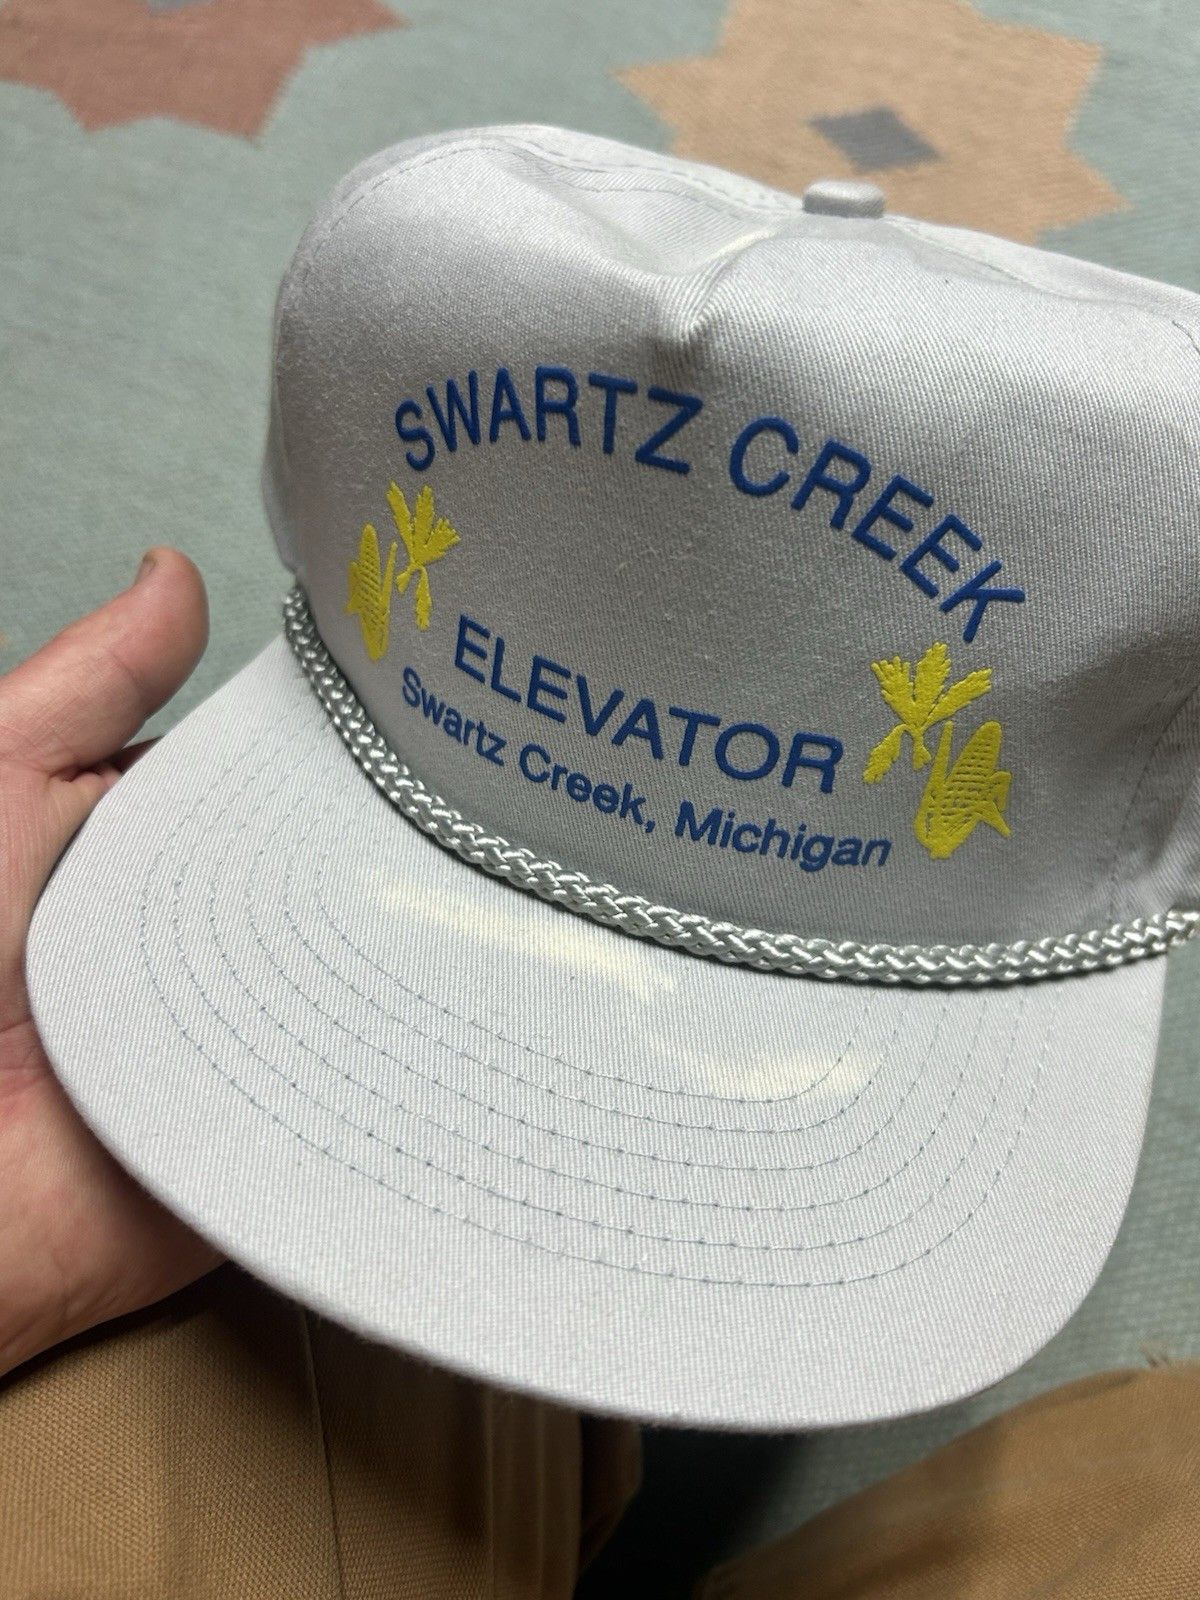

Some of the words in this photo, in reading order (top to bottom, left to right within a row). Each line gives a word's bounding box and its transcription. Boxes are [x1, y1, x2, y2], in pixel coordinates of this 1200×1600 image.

[395, 365, 704, 475] SWARTZ
[729, 416, 1026, 643] CREEK
[401, 667, 507, 767] Swartz
[519, 743, 657, 834] Creek,
[674, 800, 893, 873] Michigan
[454, 614, 844, 794] ELEVATOR
